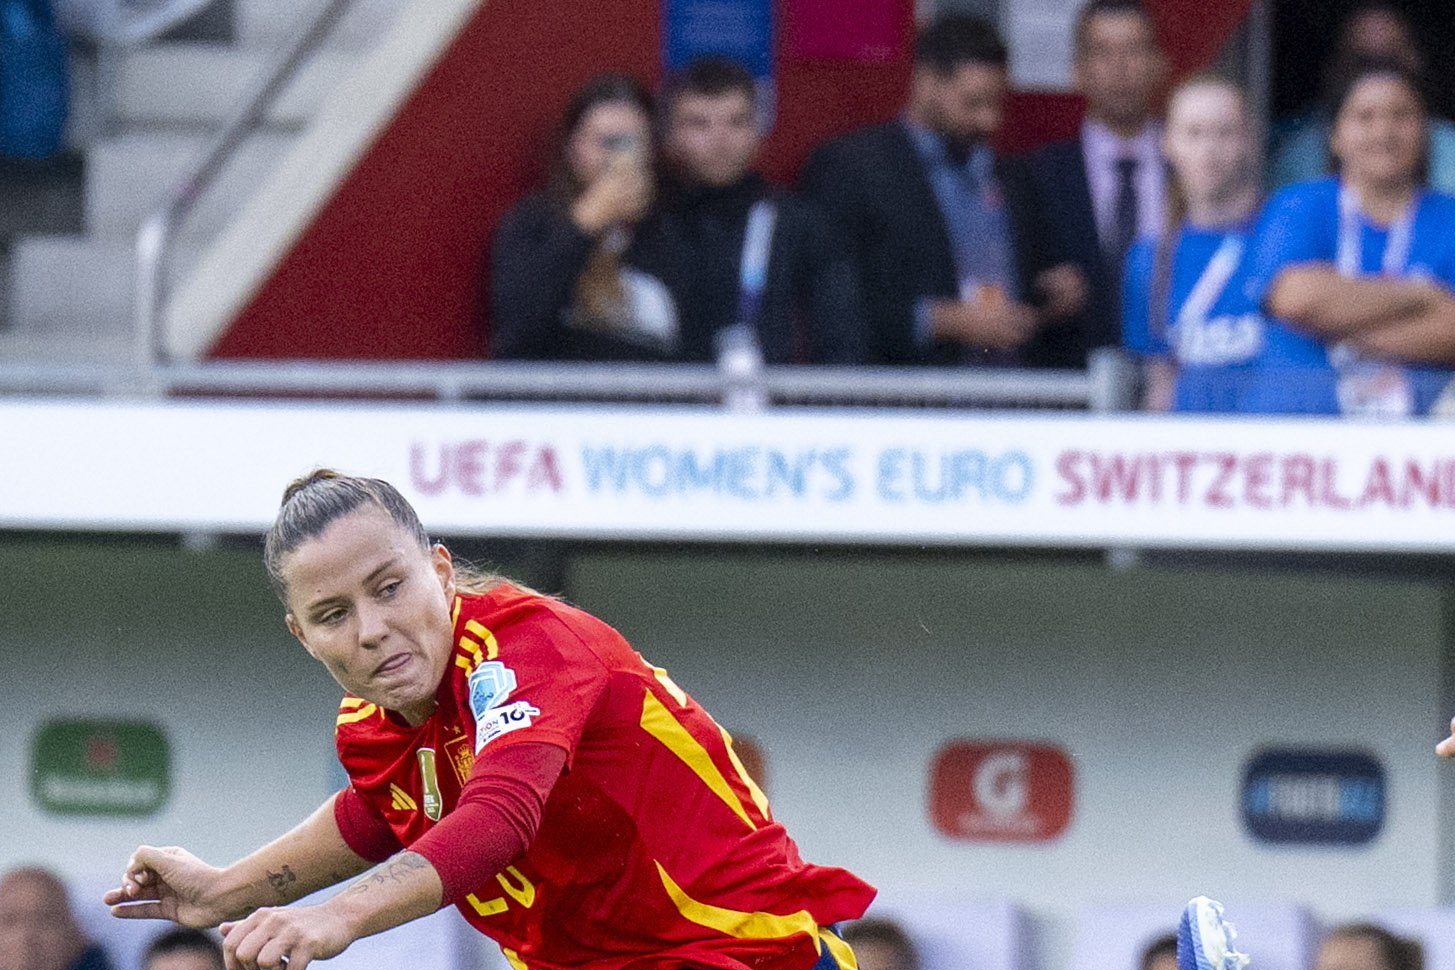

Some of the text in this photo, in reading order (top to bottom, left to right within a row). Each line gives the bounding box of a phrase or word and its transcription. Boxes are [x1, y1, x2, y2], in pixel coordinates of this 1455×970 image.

[409, 439, 564, 497] UEFA
[581, 443, 855, 502] WOMEN'S
[875, 447, 1036, 504] EURO
